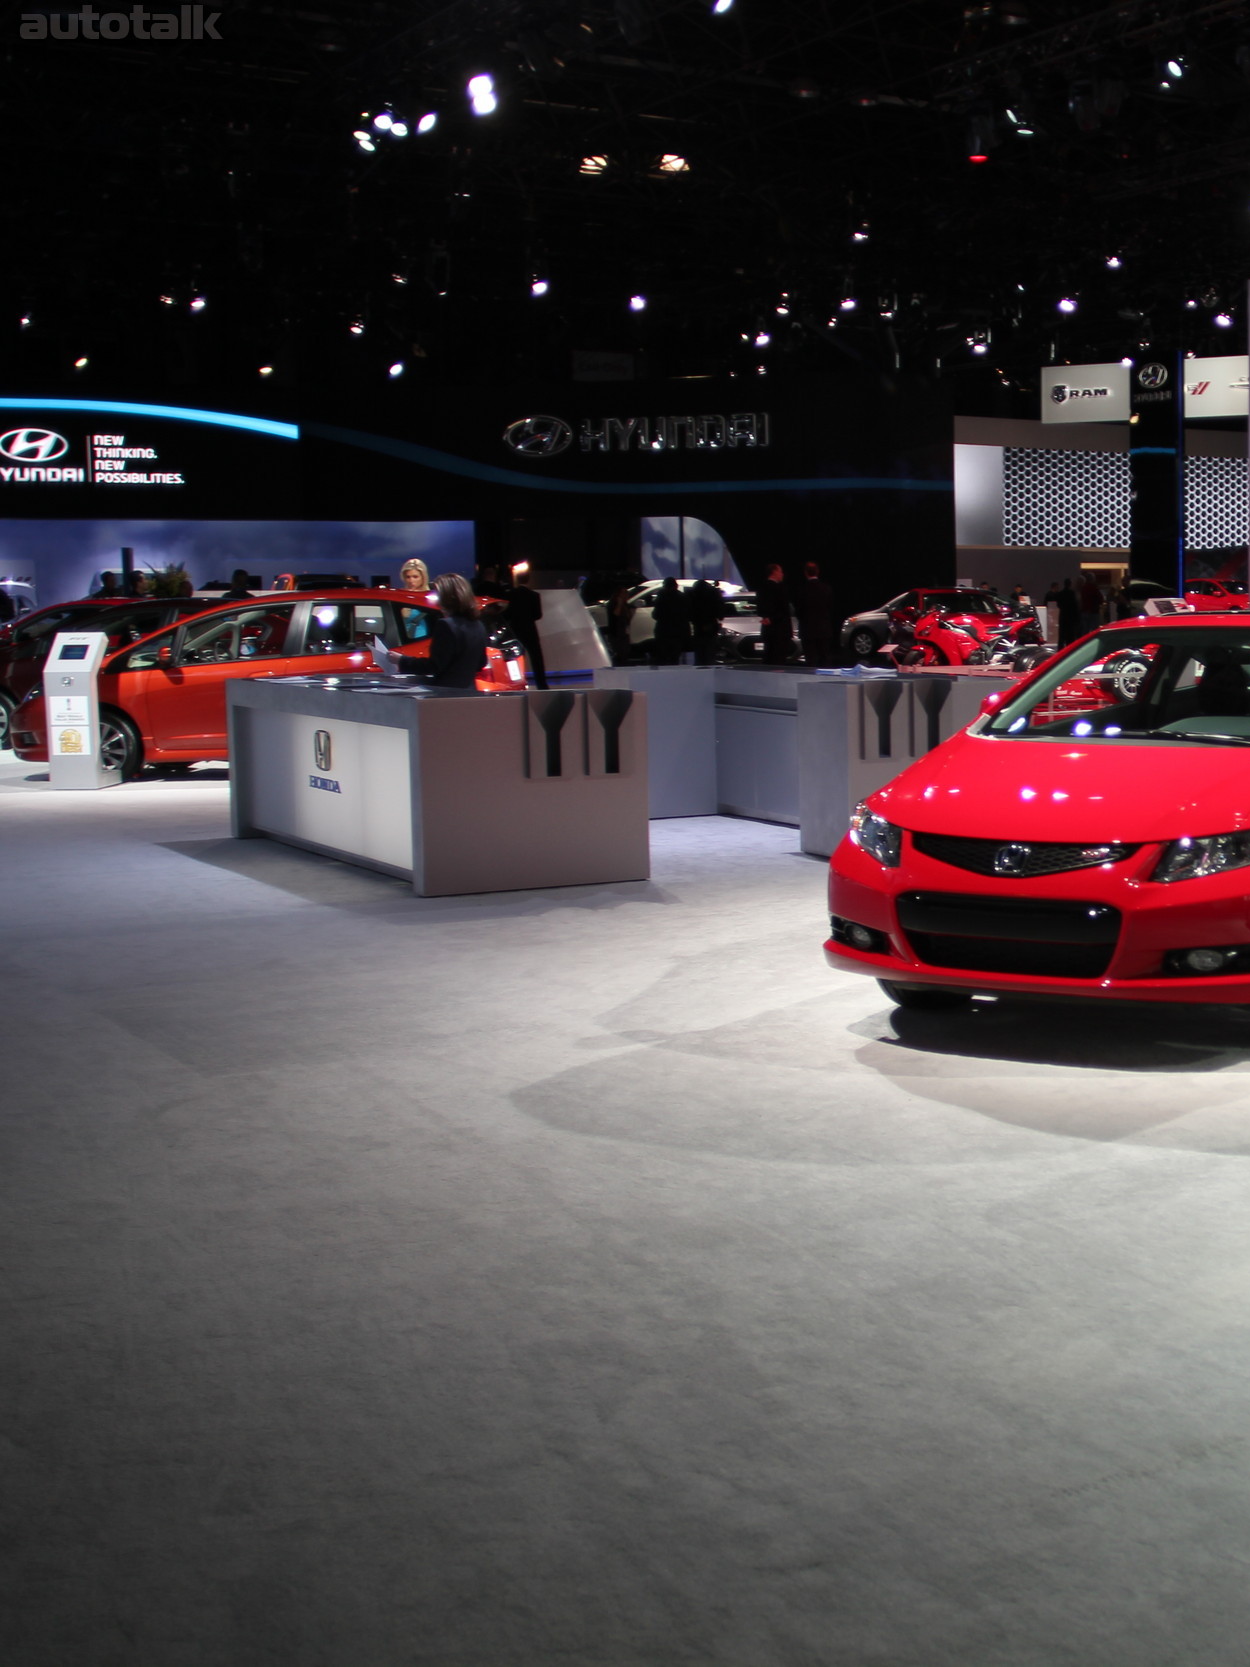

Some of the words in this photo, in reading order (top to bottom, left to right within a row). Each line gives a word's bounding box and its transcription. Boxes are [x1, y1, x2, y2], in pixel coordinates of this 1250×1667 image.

[1070, 388, 1108, 397] RAM
[580, 412, 769, 452] HYUNDAI
[93, 435, 124, 446] NEW
[93, 447, 157, 459] THINKING.
[94, 460, 125, 471] NEW
[0, 467, 84, 482] YUNDAI
[95, 472, 185, 484] POSSIBILITIES.
